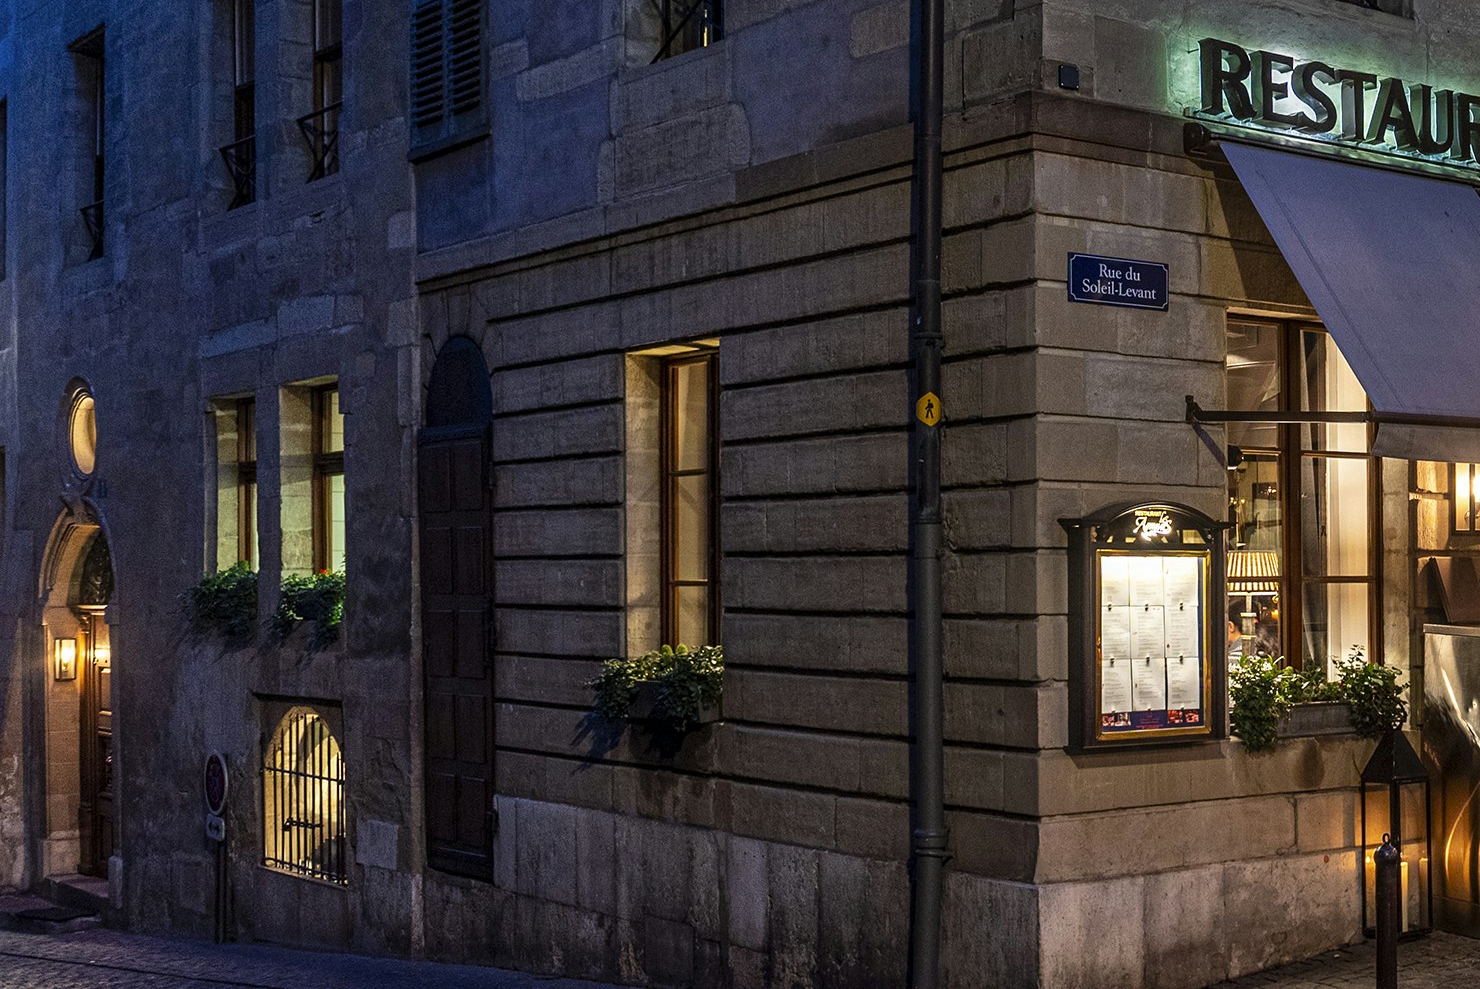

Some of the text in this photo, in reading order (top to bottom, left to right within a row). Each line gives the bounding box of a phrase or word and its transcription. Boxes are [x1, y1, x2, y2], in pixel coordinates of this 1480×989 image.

[1099, 263, 1141, 281] Rue du
[1082, 278, 1156, 300] Soleil-Levant
